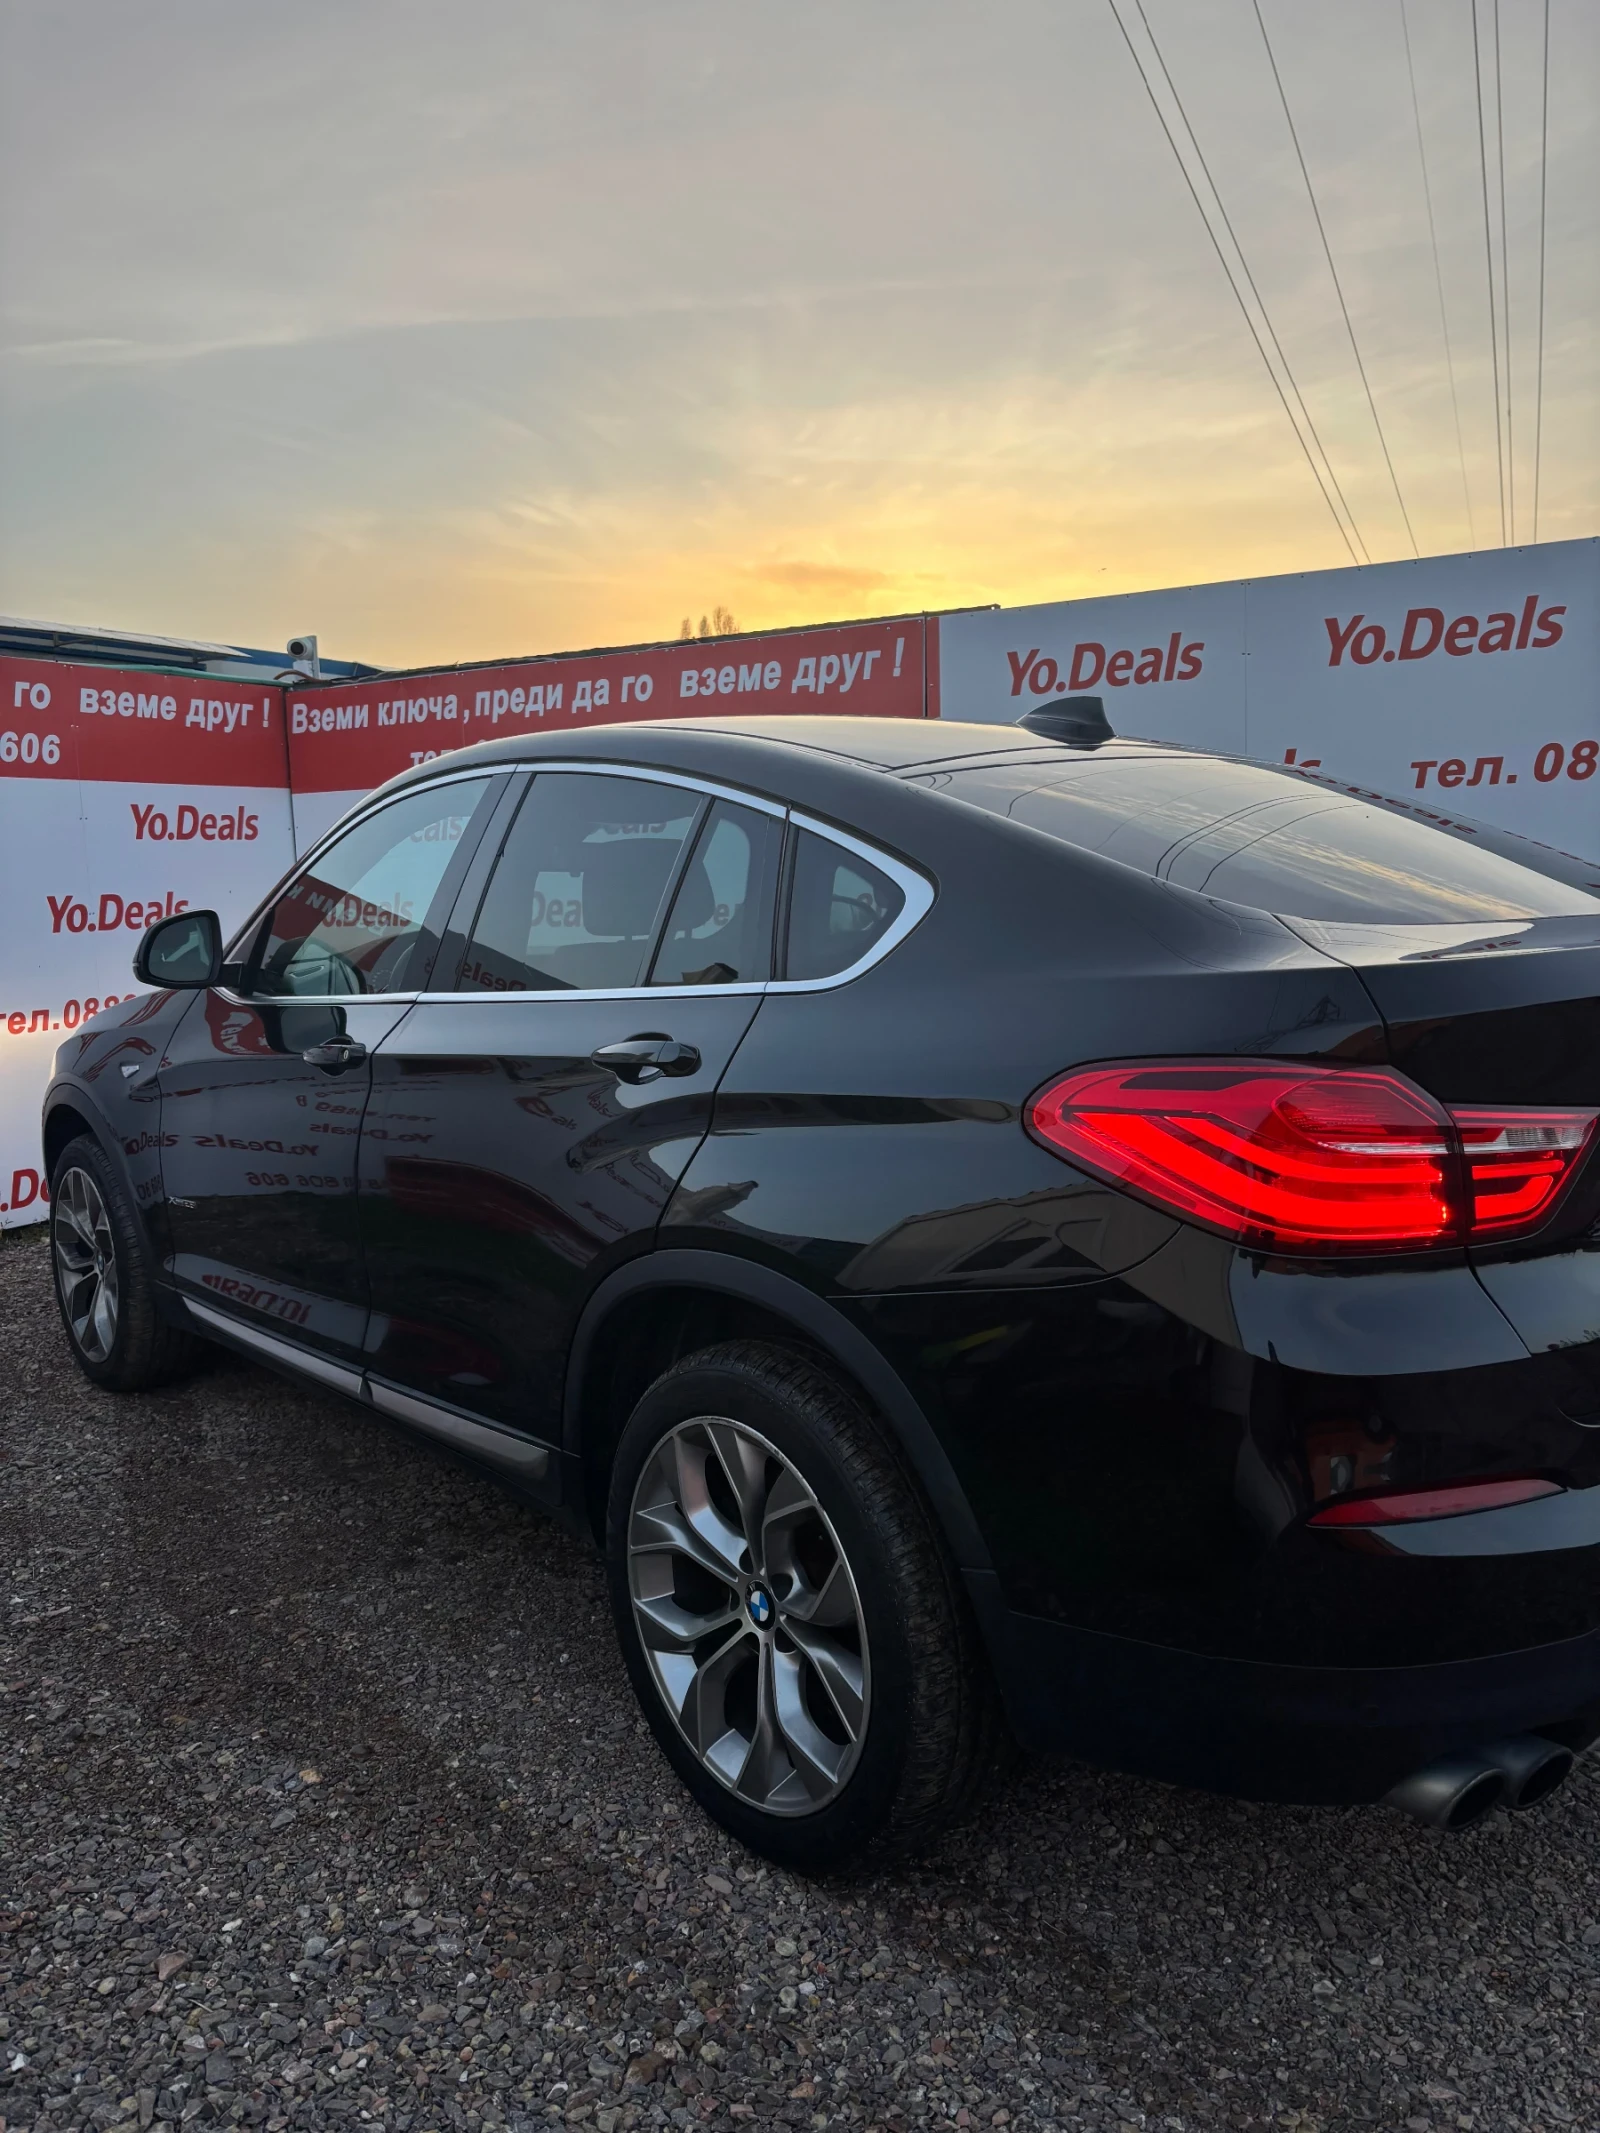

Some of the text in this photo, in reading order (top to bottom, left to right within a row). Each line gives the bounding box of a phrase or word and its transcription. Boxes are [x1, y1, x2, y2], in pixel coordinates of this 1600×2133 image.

[1324, 595, 1567, 667] Yo.Deals
[292, 704, 369, 734] Вземи
[572, 678, 610, 713] да
[621, 674, 654, 702] го
[680, 660, 782, 698] вземе
[791, 649, 881, 694] друг
[1007, 633, 1204, 696] Yo.Deals
[14, 681, 51, 710] го
[79, 687, 177, 721] вземе
[185, 698, 254, 733] друг
[1411, 756, 1518, 789] тел.
[130, 804, 259, 841] Yo.Deals
